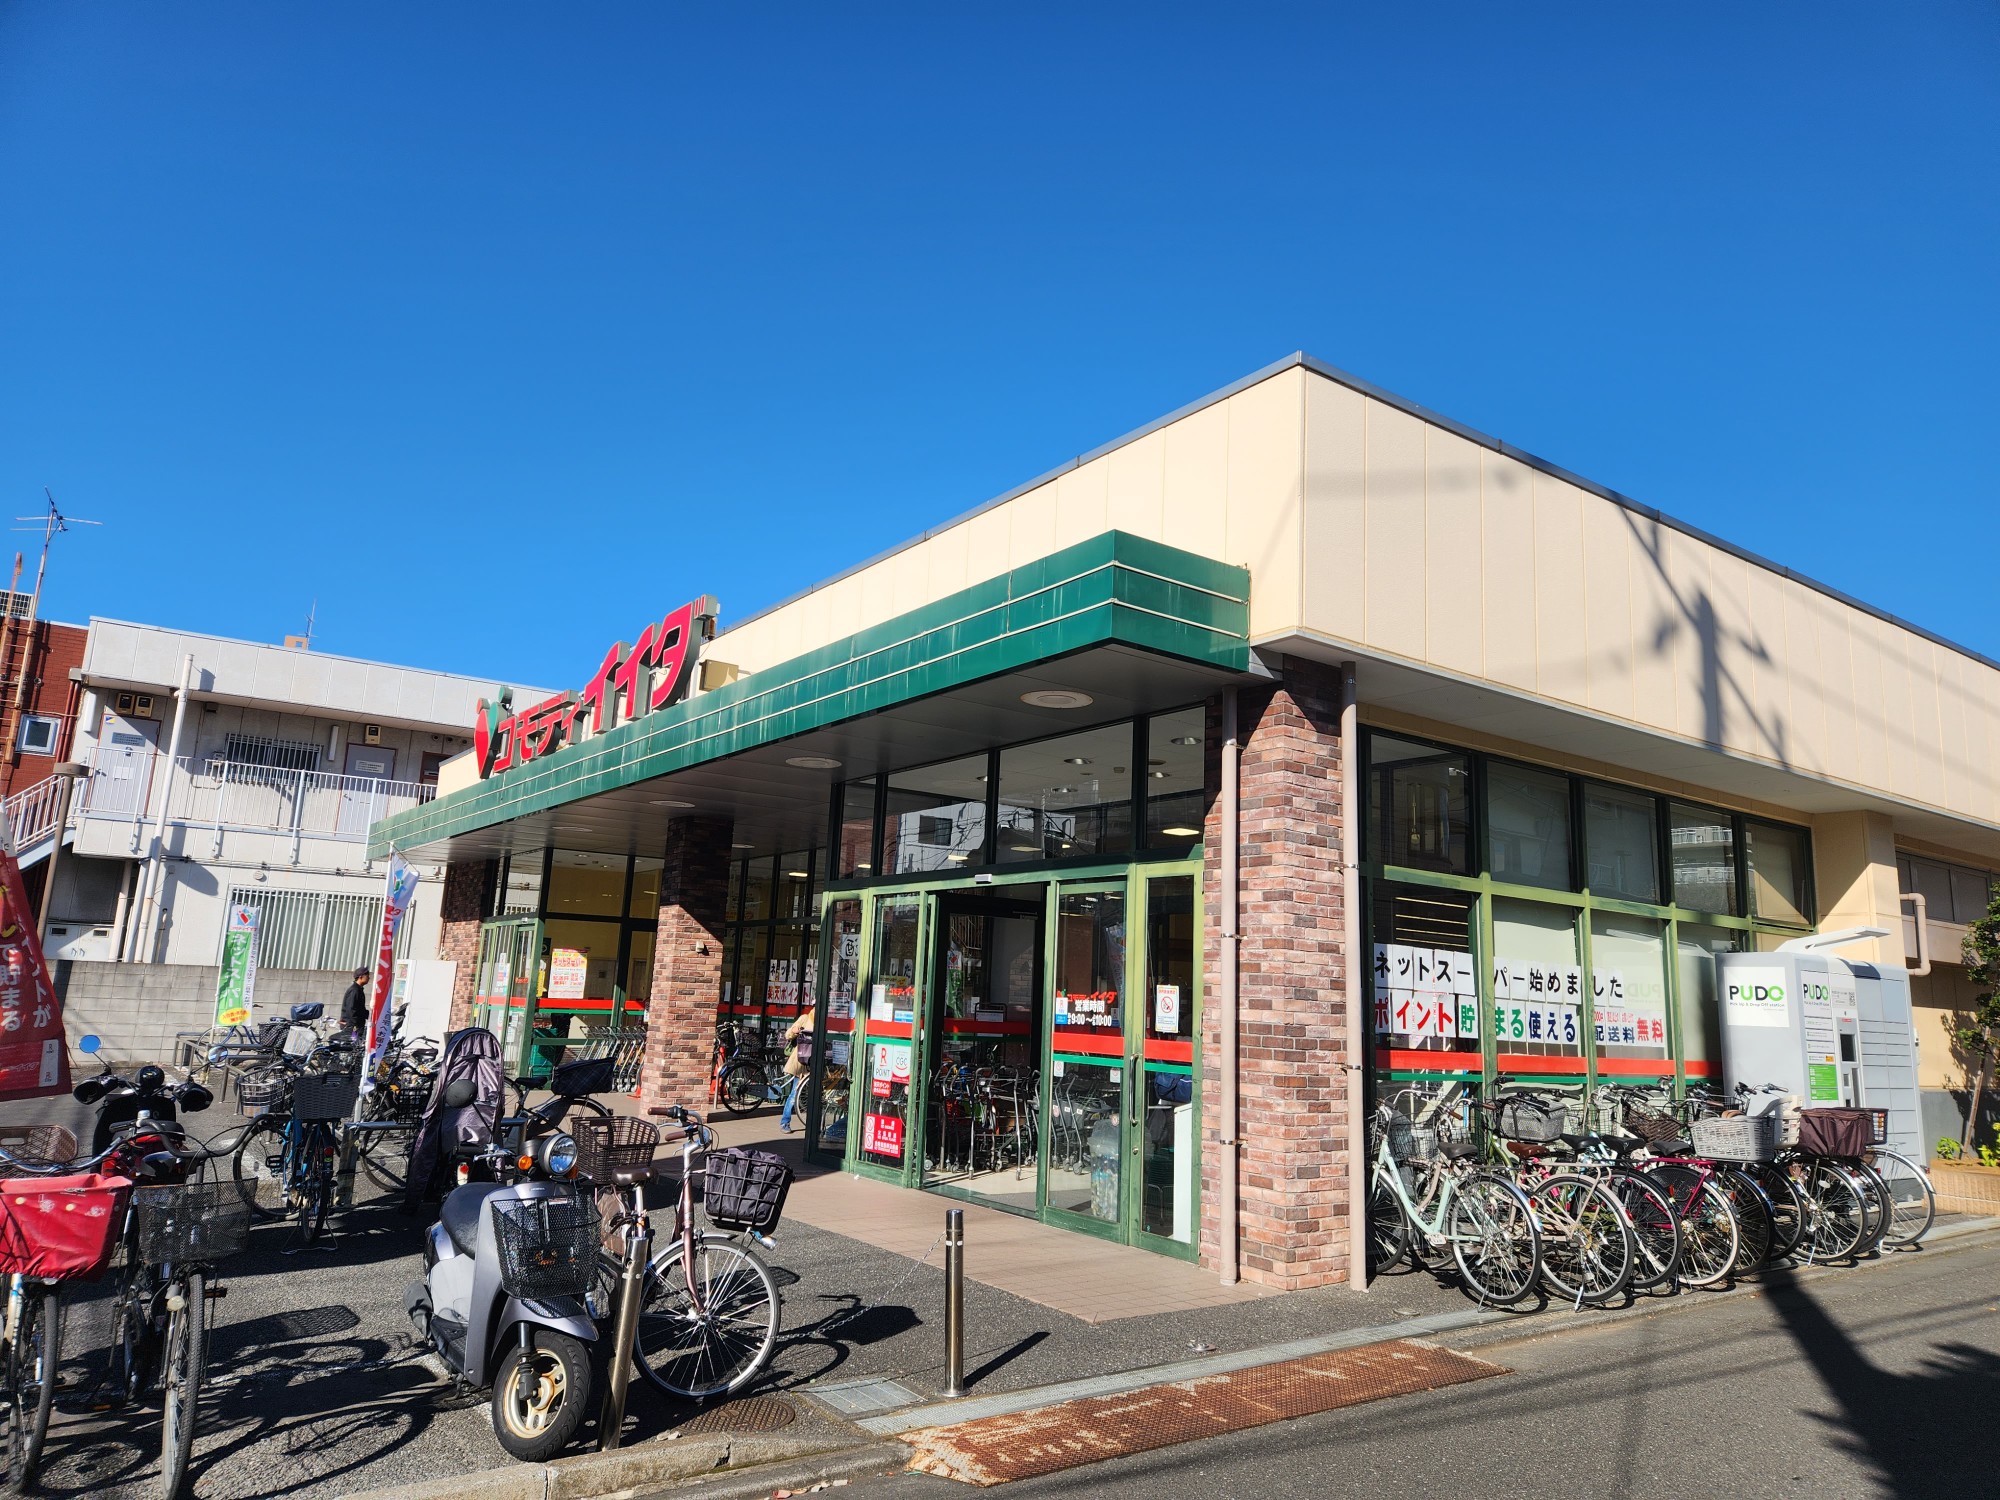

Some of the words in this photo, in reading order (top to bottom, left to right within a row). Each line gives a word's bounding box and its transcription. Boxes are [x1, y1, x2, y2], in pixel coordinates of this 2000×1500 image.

[493, 594, 711, 773] コモディイイダ
[223, 933, 247, 1007] ネットスーパー
[1729, 985, 1784, 1001] PUDO
[1803, 984, 1829, 1001] PUDO
[1075, 999, 1105, 1013] 営業時間
[1594, 1018, 1664, 1043] 配送料無料
[895, 1056, 908, 1066] CGC
